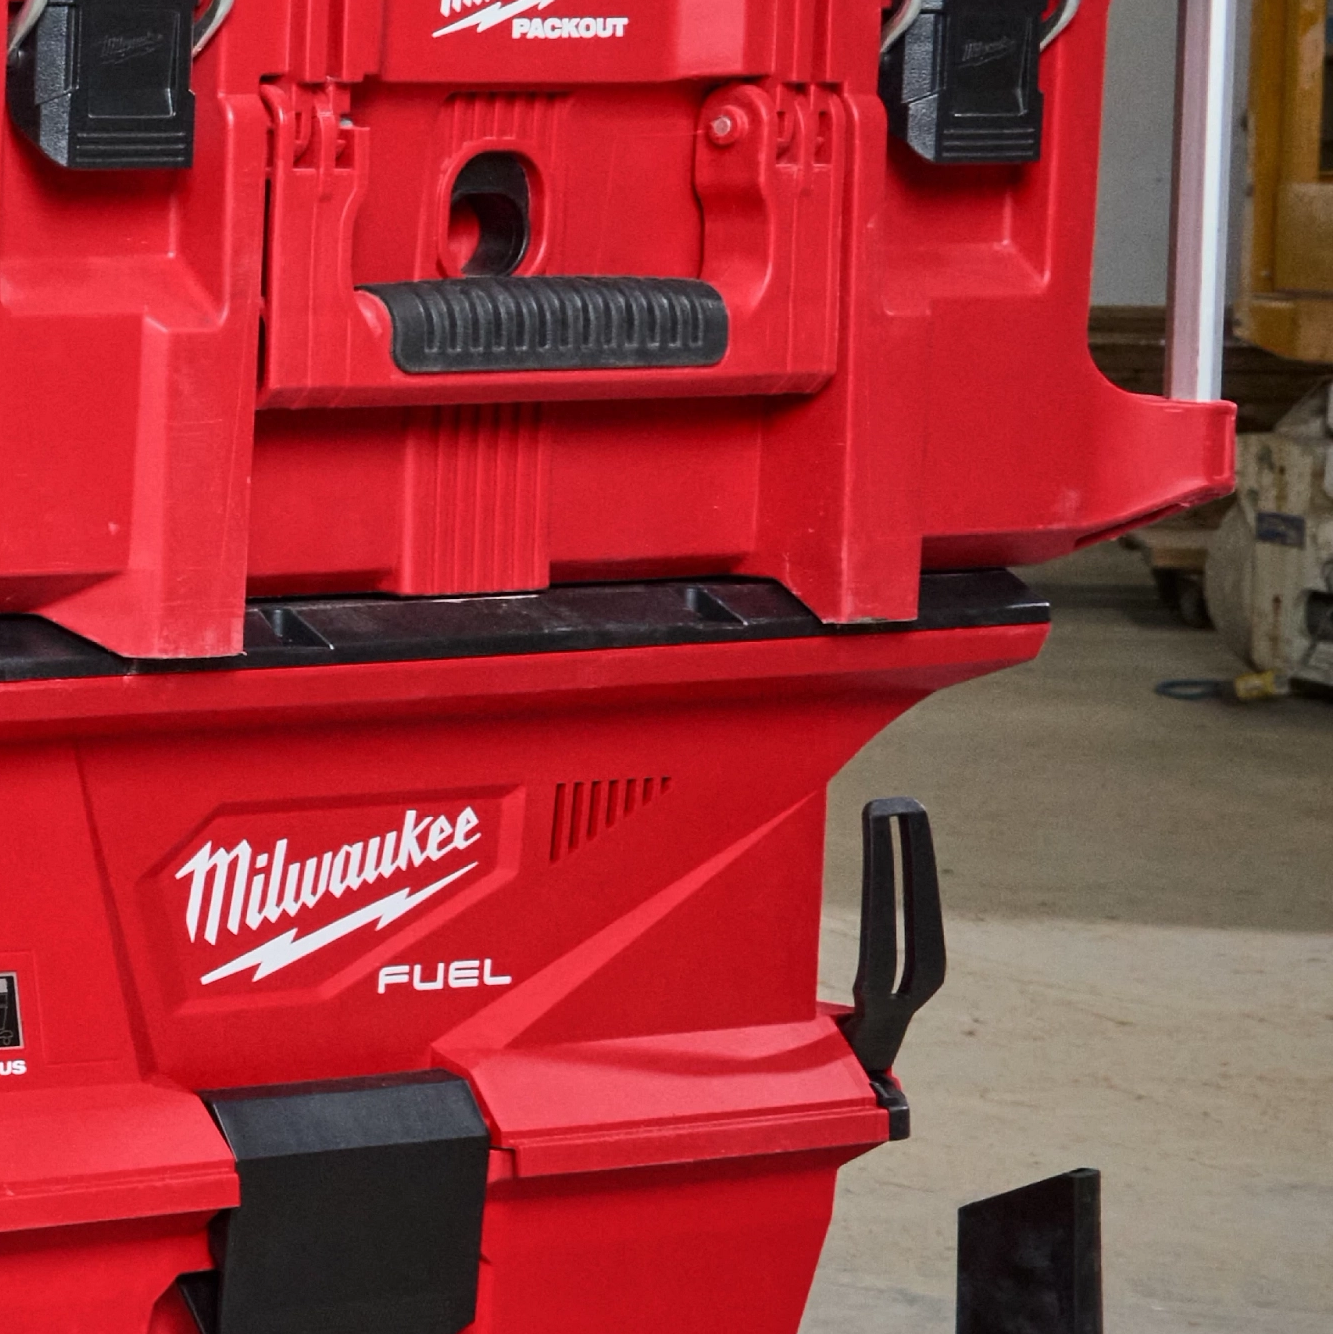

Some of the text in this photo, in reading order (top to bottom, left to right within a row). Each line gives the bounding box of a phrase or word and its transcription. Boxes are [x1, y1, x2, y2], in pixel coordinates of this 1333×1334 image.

[511, 17, 629, 39] PACKOUT
[175, 806, 481, 945] Milwaukee
[377, 958, 512, 994] FUEL
